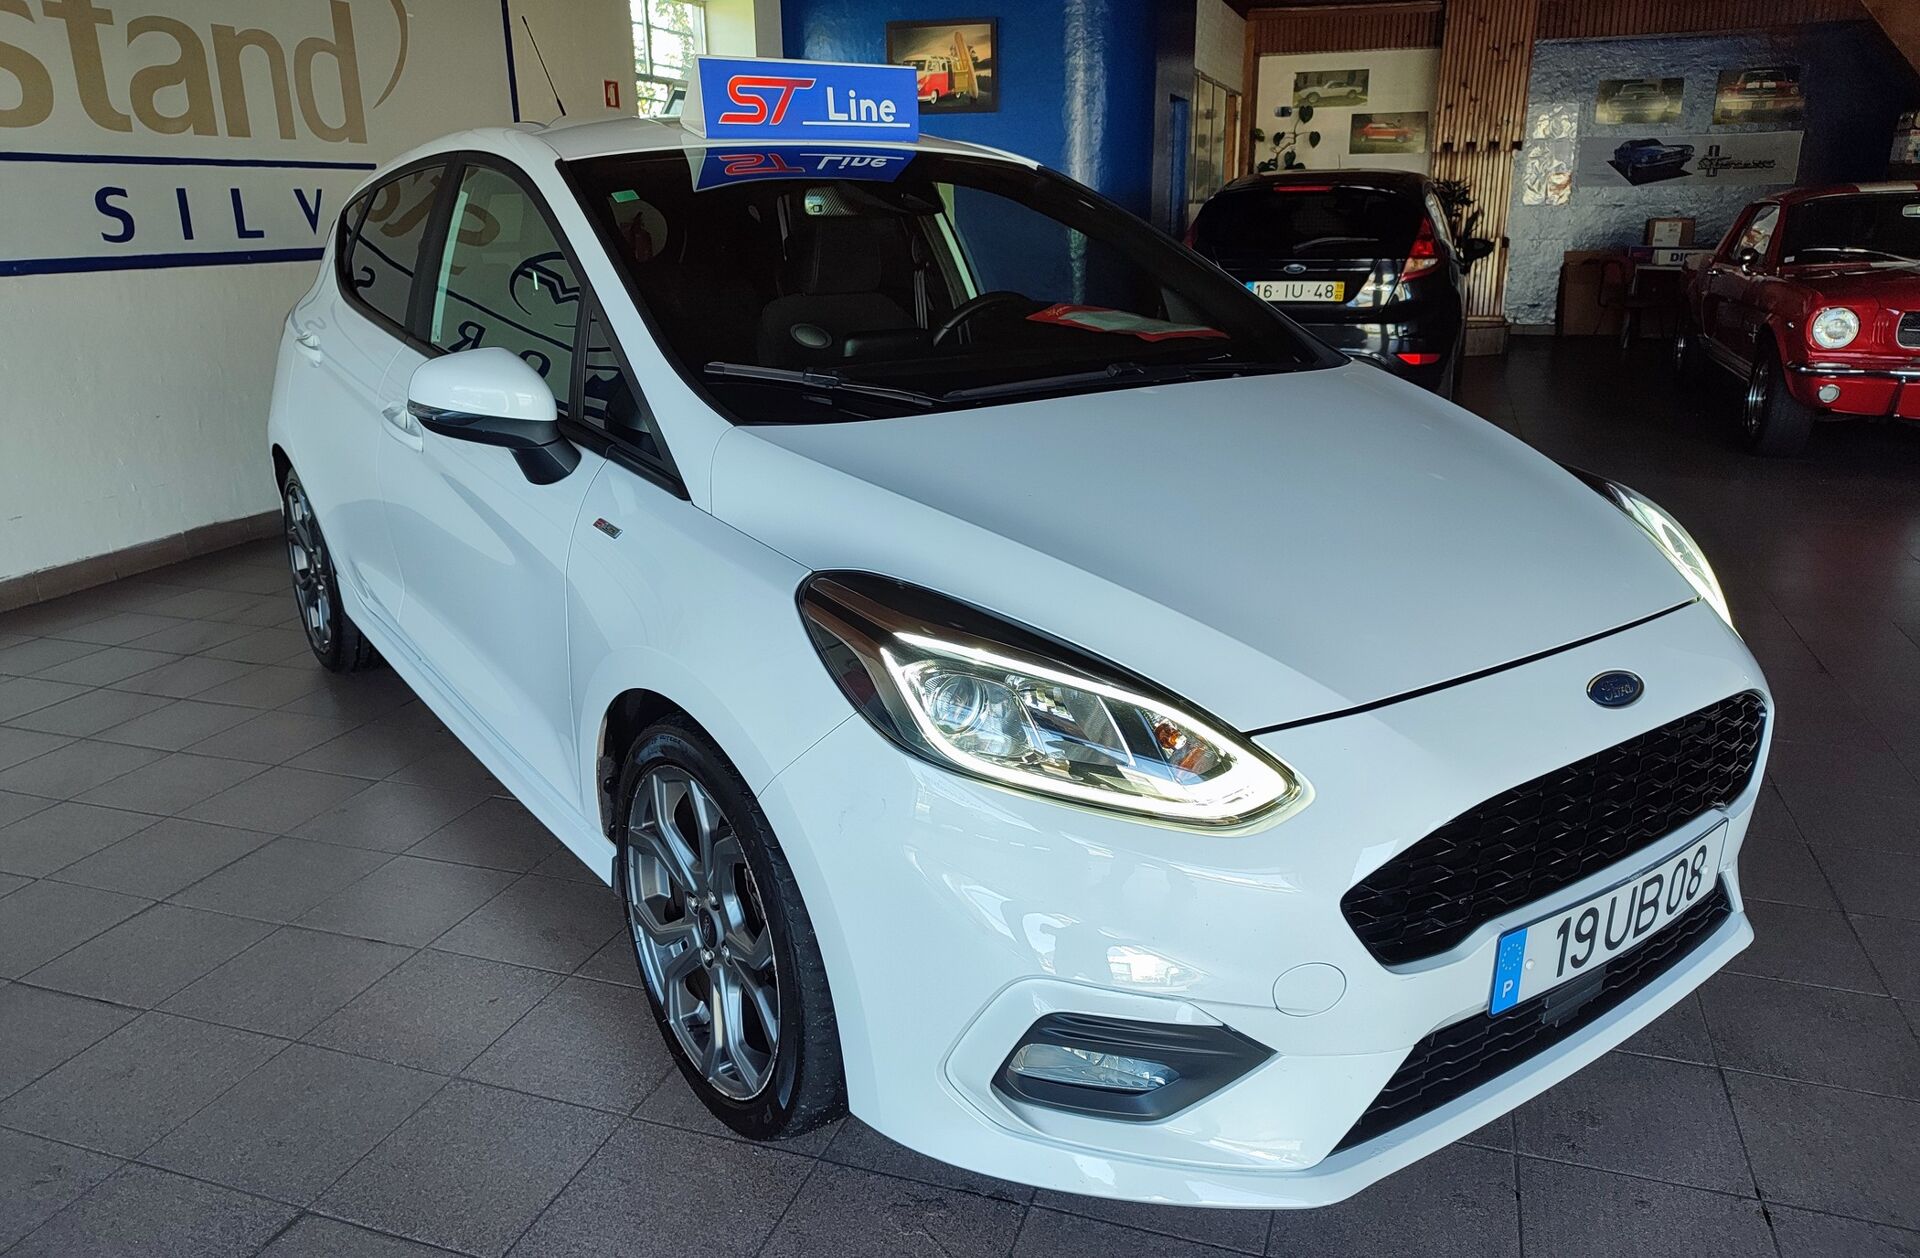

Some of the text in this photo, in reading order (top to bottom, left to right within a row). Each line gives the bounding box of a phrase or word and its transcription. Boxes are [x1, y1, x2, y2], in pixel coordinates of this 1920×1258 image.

[718, 75, 896, 126] ST Line
[94, 186, 323, 244] SILV
[1670, 252, 1688, 262] DI
[1501, 979, 1514, 999] P
